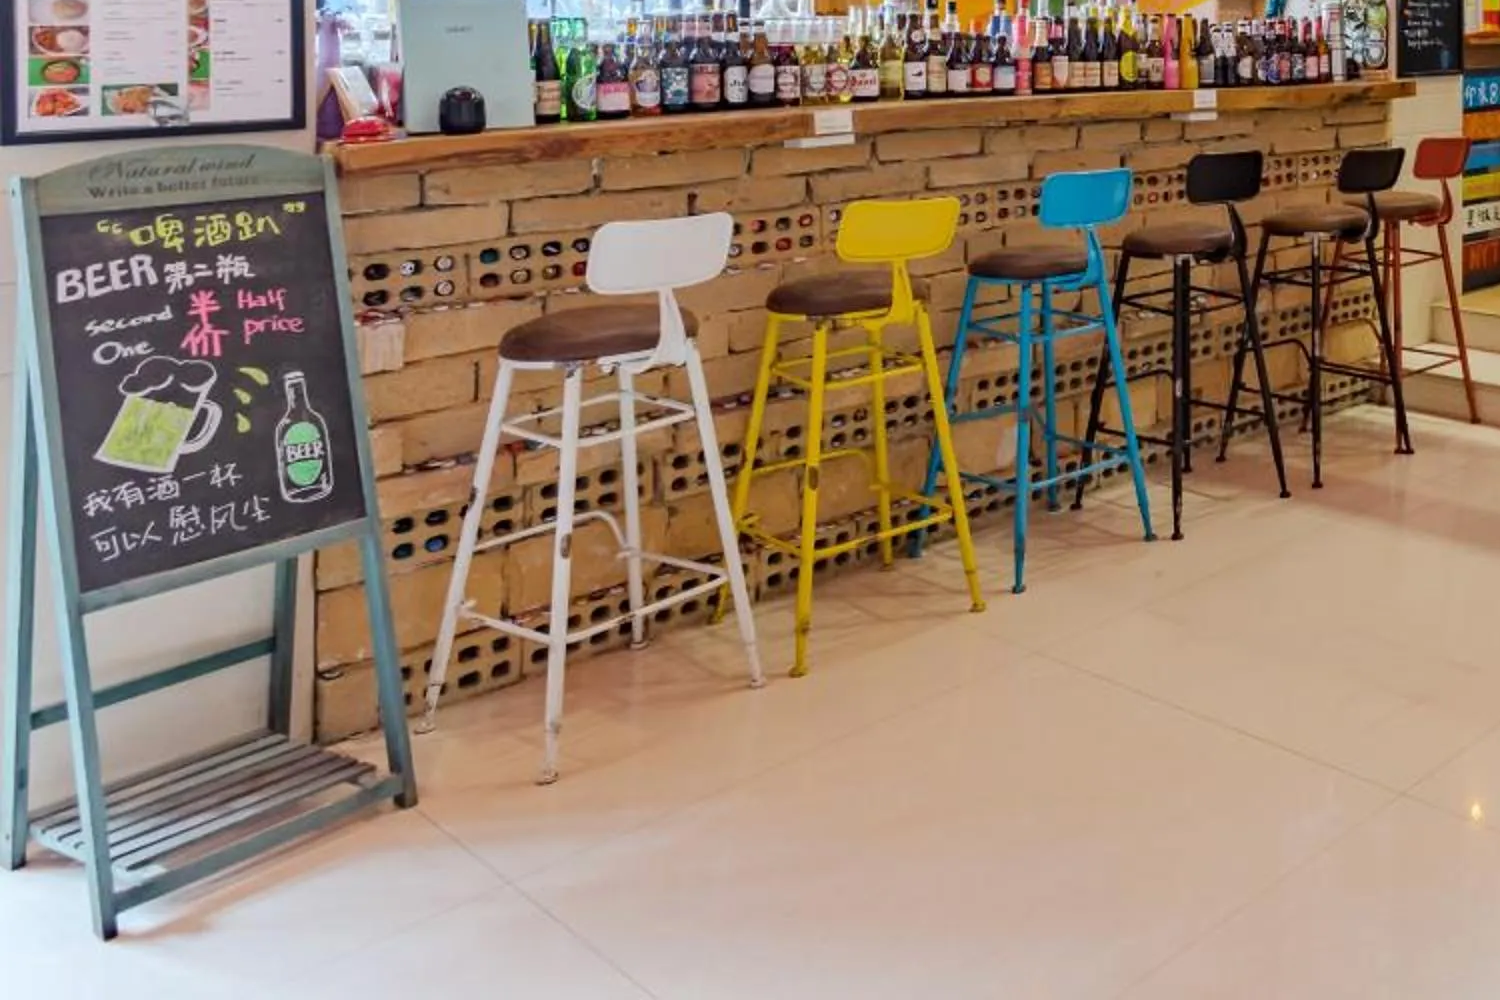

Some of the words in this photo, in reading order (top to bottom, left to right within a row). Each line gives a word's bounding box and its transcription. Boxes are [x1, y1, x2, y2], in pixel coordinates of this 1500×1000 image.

[57, 253, 158, 303] BEER
[163, 253, 256, 295] 第二瓶
[237, 287, 288, 311] Half
[85, 304, 173, 337] second
[179, 289, 232, 358] 半价
[243, 315, 305, 345] price
[92, 340, 155, 366] One
[285, 440, 324, 461] BEER
[82, 462, 244, 518] 我有酒一杯
